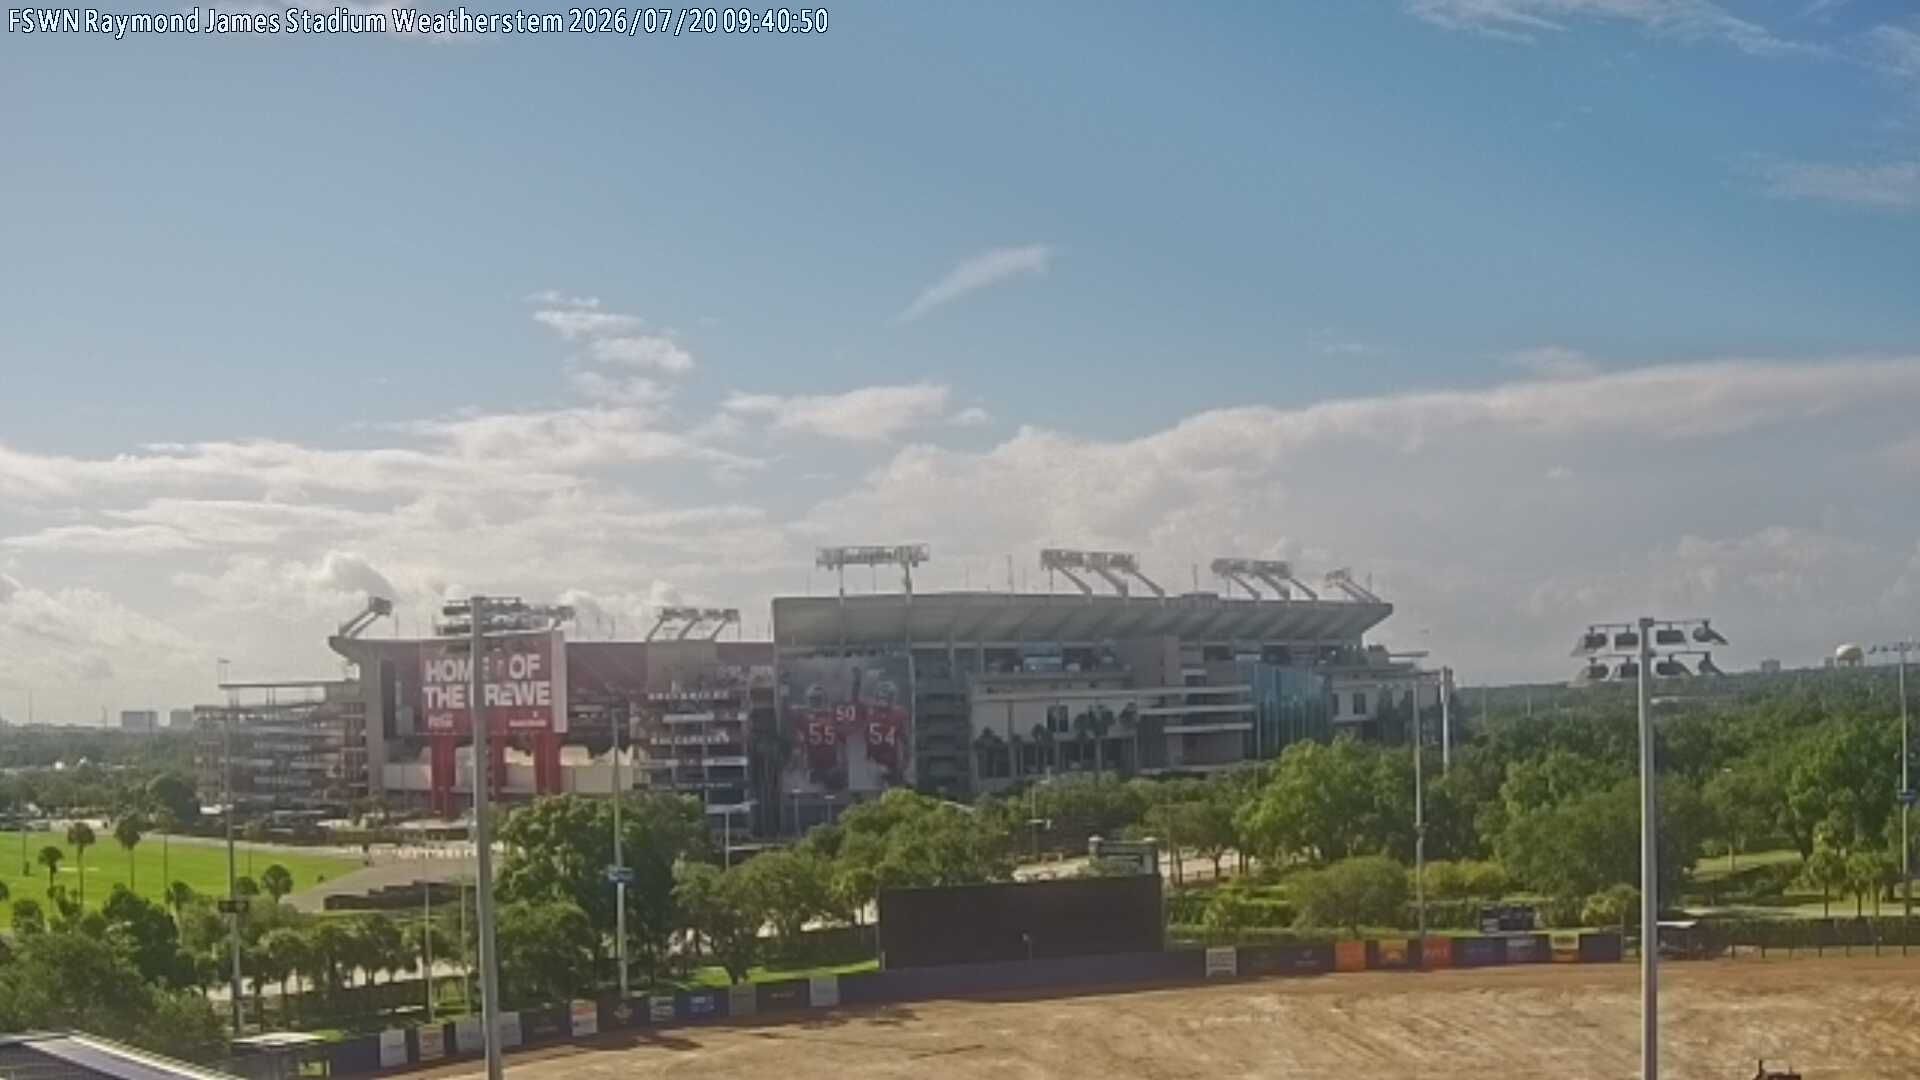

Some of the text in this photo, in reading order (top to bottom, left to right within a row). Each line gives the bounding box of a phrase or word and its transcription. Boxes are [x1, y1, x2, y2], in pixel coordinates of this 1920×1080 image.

[508, 654, 541, 679] OF
[422, 685, 465, 709] THE
[808, 721, 835, 745] 55
[869, 722, 896, 746] 54
